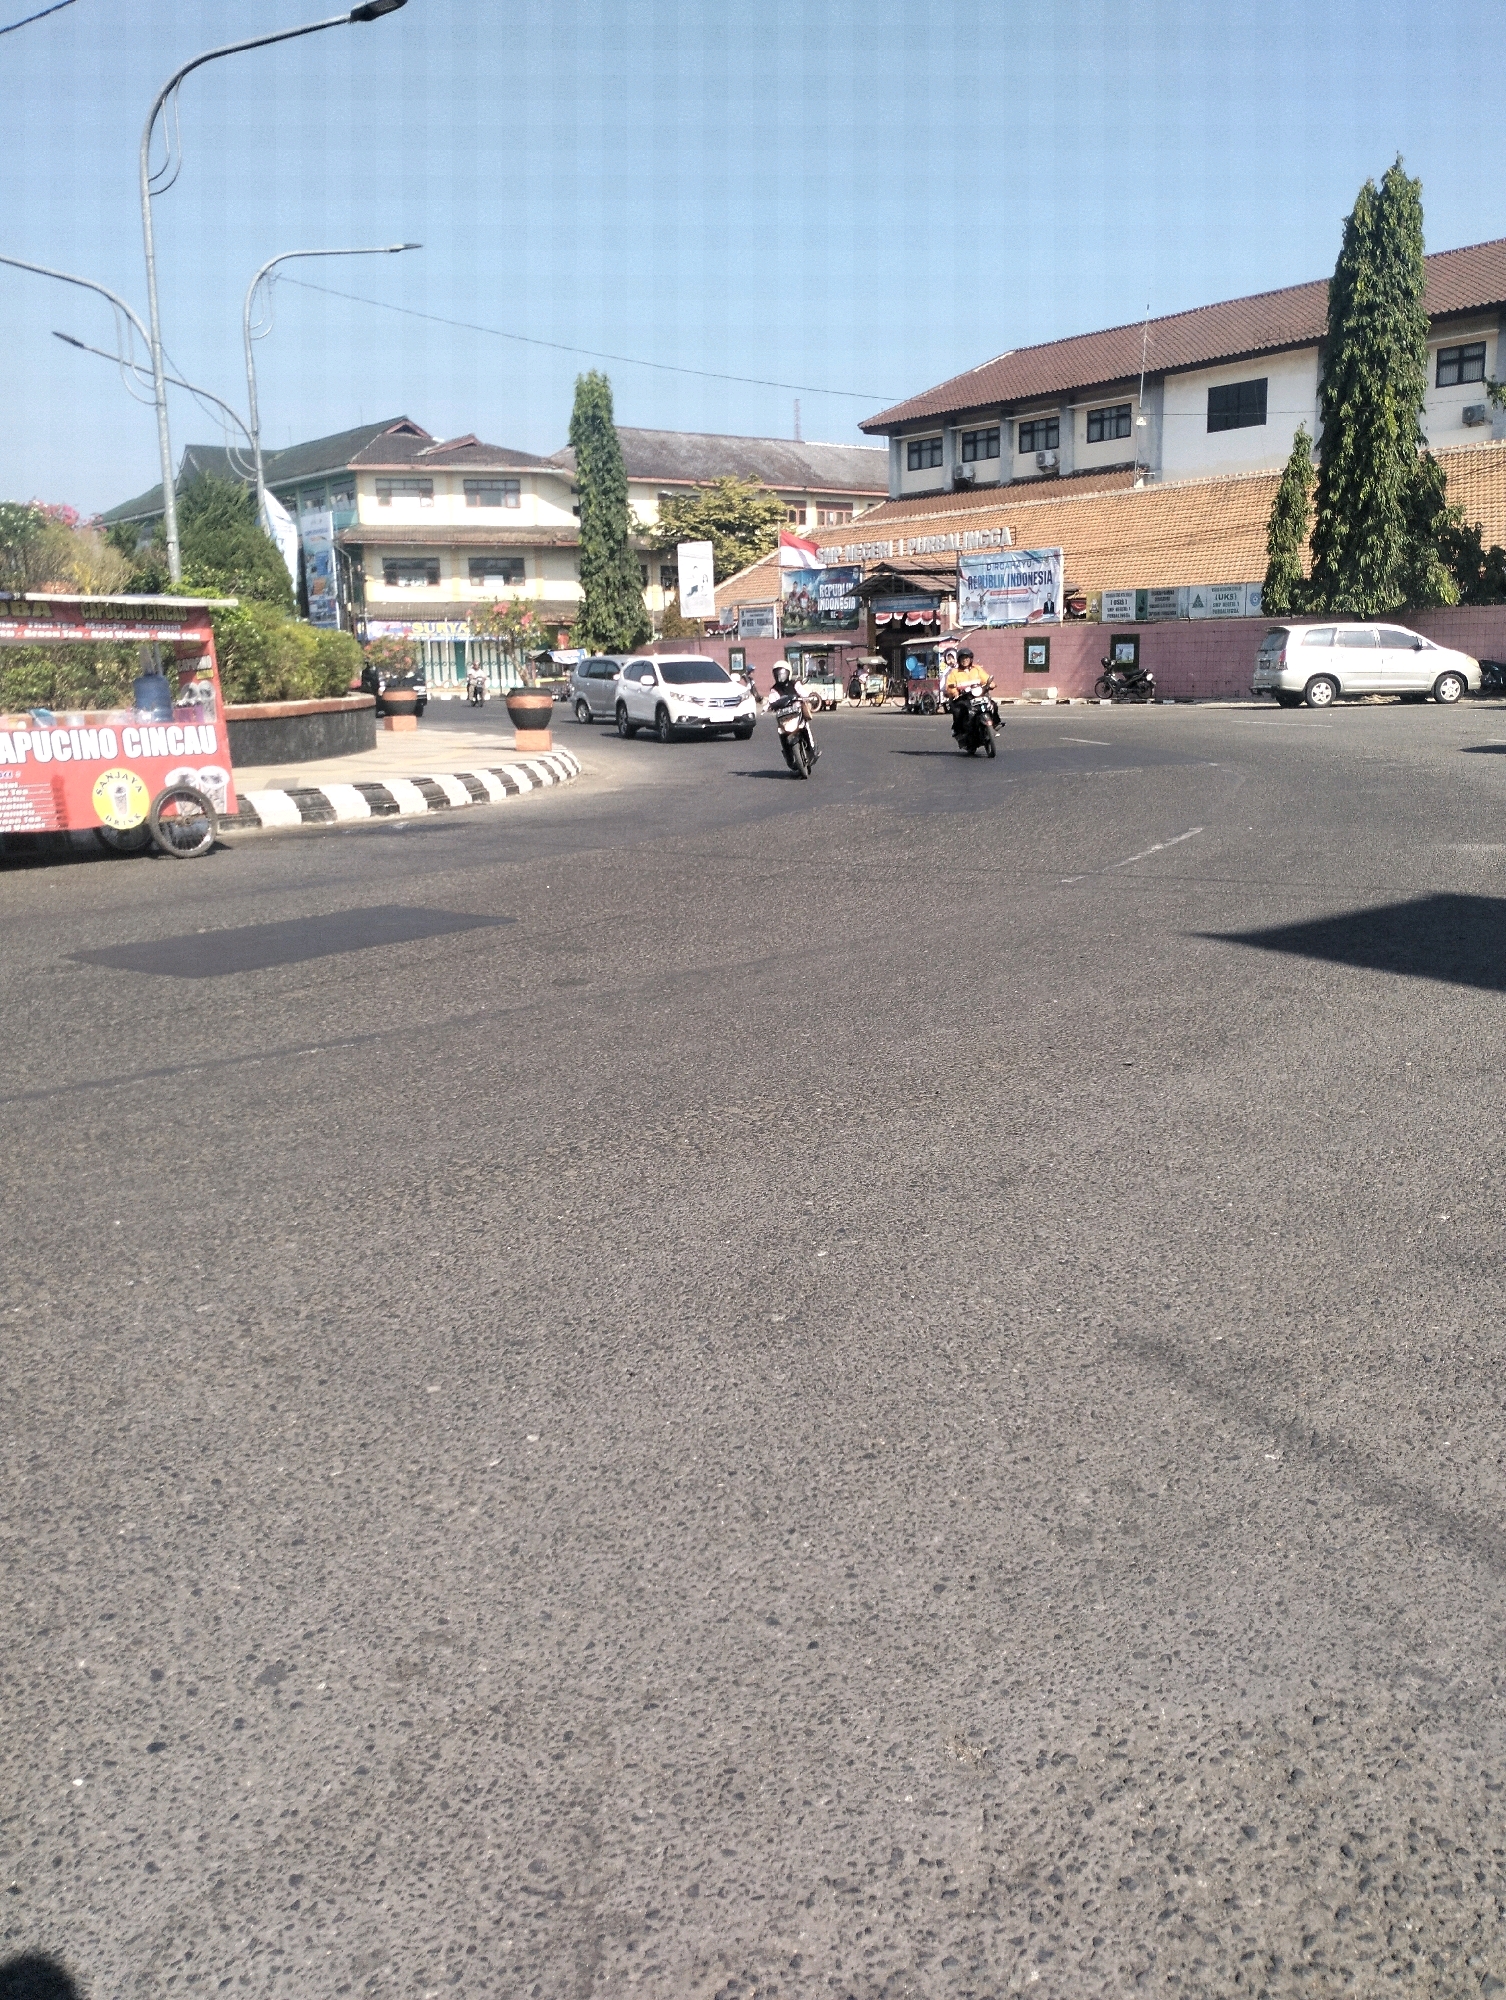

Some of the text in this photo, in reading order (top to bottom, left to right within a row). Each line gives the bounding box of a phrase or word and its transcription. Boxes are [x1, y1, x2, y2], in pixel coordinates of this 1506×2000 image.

[816, 546, 843, 564] SMP
[845, 540, 892, 562] NEGERI
[907, 526, 1012, 556] PURBALINGGA
[967, 569, 1053, 590] REPUBLIK INDONESIA
[817, 596, 856, 611] INDONESIA
[121, 725, 218, 759] CINCAU
[95, 771, 142, 796] SANJAYA
